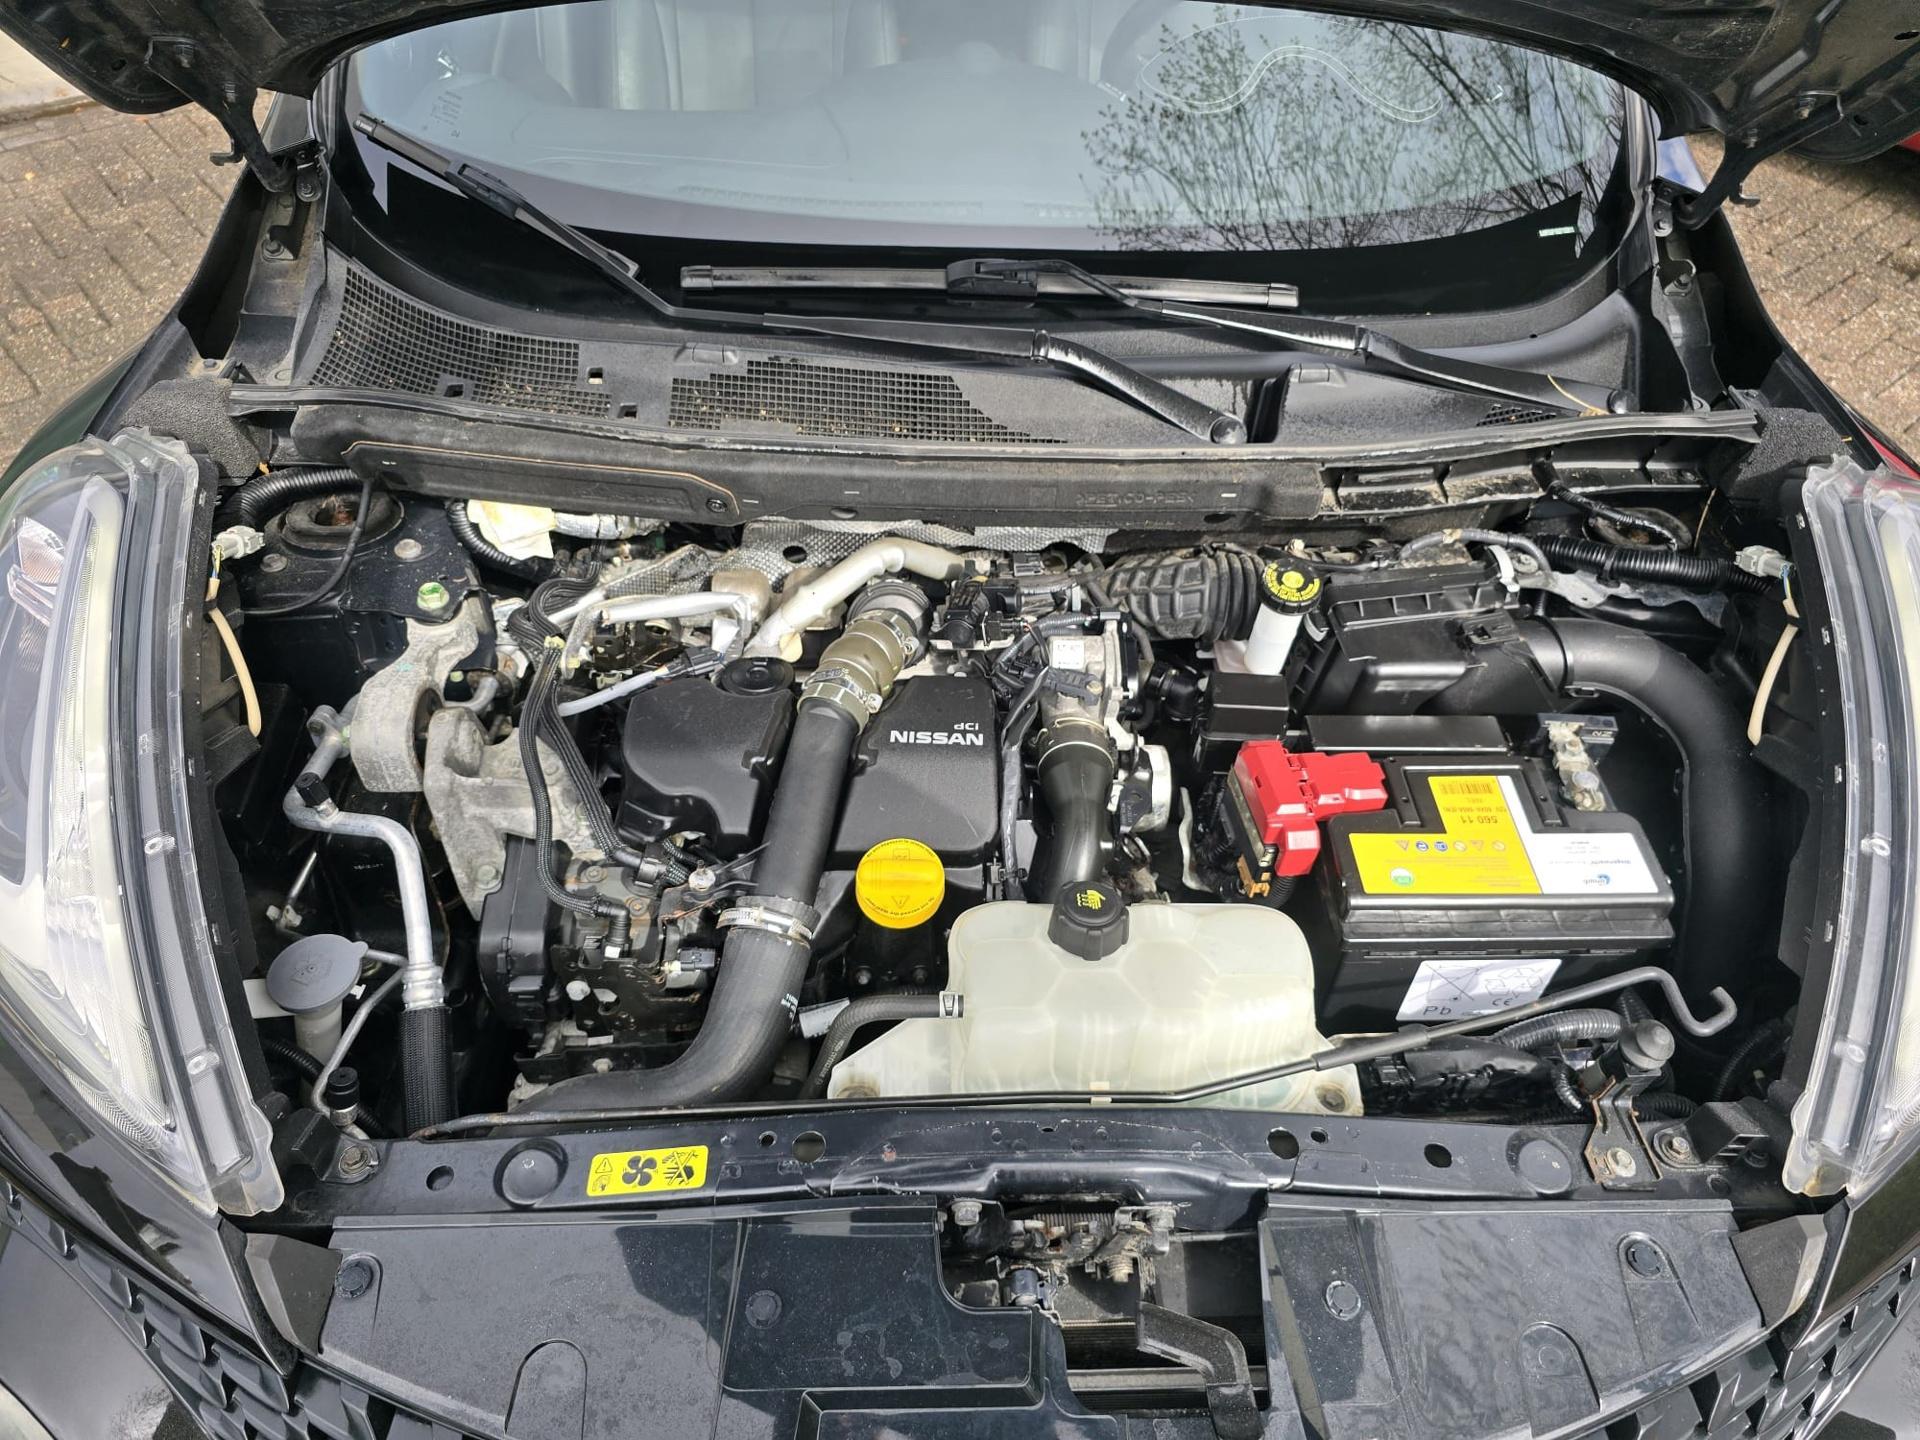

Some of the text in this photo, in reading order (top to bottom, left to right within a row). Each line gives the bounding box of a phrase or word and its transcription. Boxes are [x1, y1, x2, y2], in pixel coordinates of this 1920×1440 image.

[953, 722, 979, 731] dCi
[889, 730, 984, 746] NISSAN
[1460, 815, 1474, 824] 11
[1423, 1005, 1452, 1015] Pb
